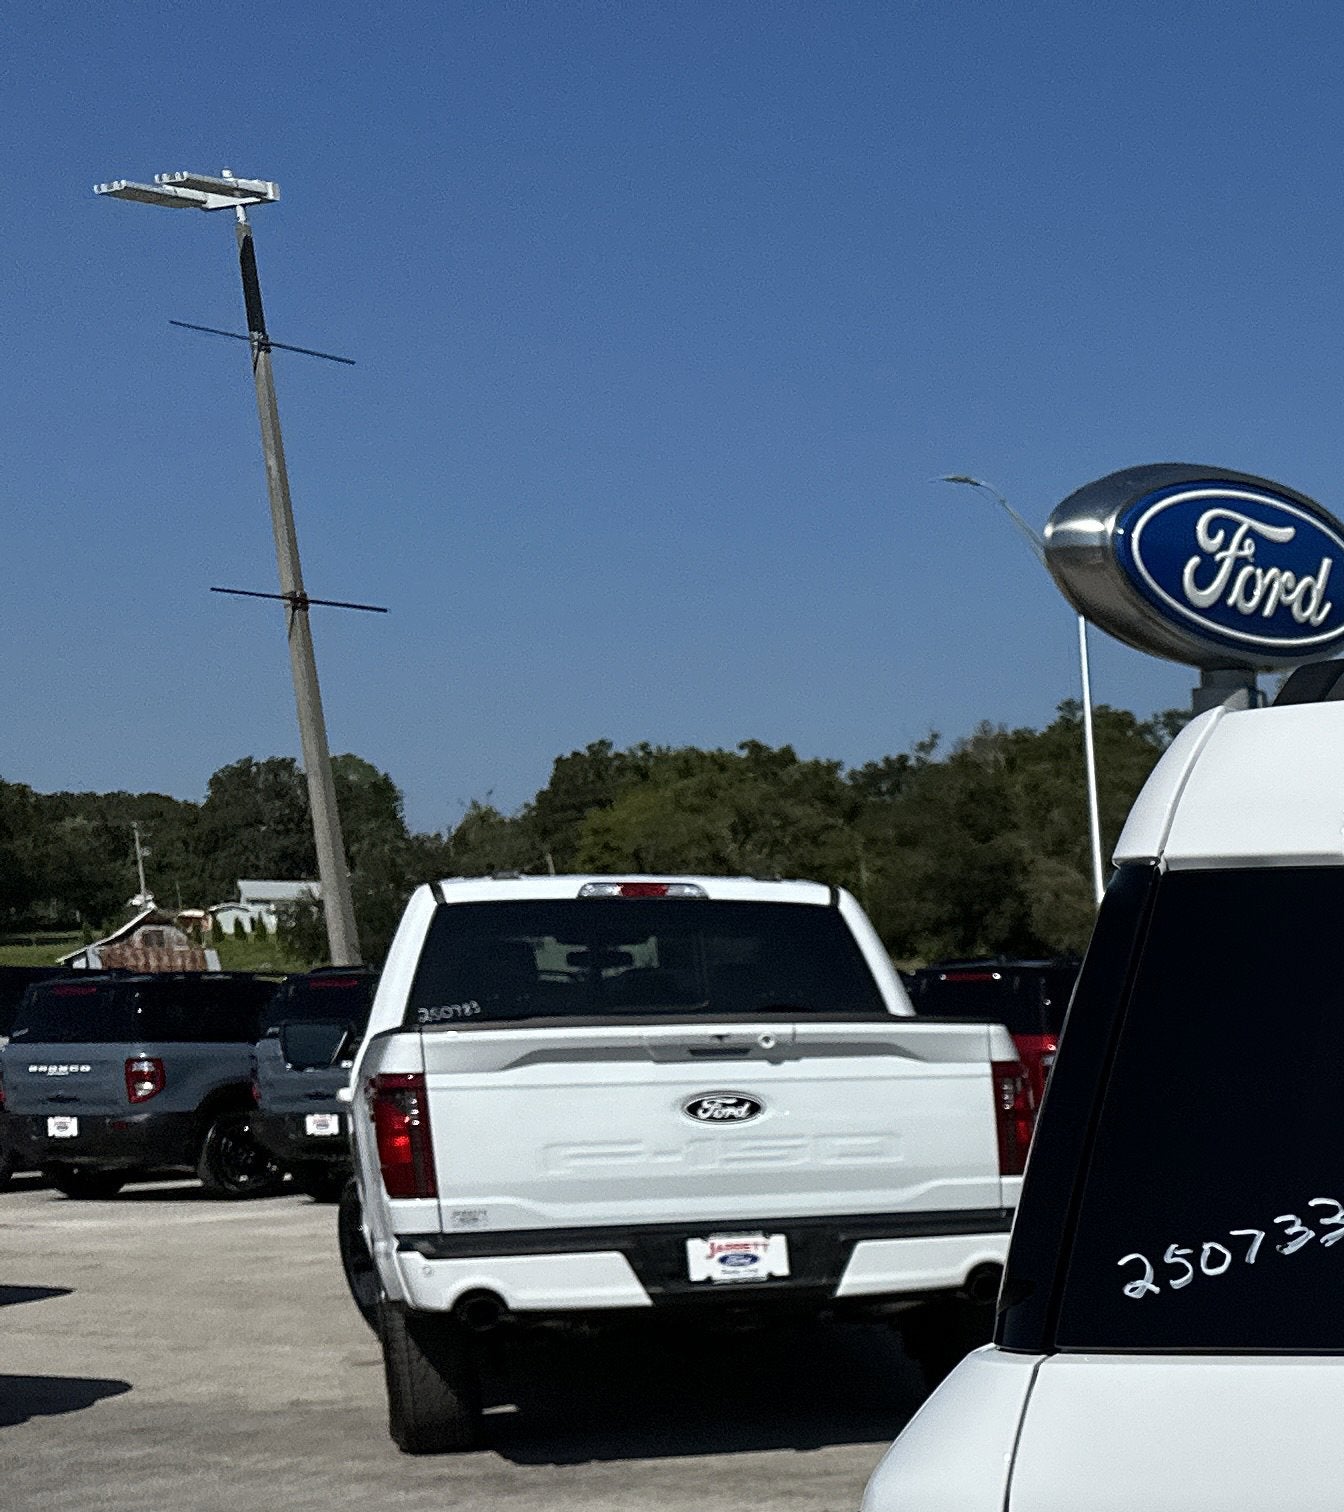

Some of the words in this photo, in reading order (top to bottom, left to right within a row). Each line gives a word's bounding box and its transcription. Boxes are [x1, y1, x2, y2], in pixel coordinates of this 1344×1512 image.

[1182, 507, 1333, 627] Ford
[28, 1064, 92, 1073] BRONCO
[696, 1097, 752, 1119] Ford
[542, 1133, 905, 1175] F-150
